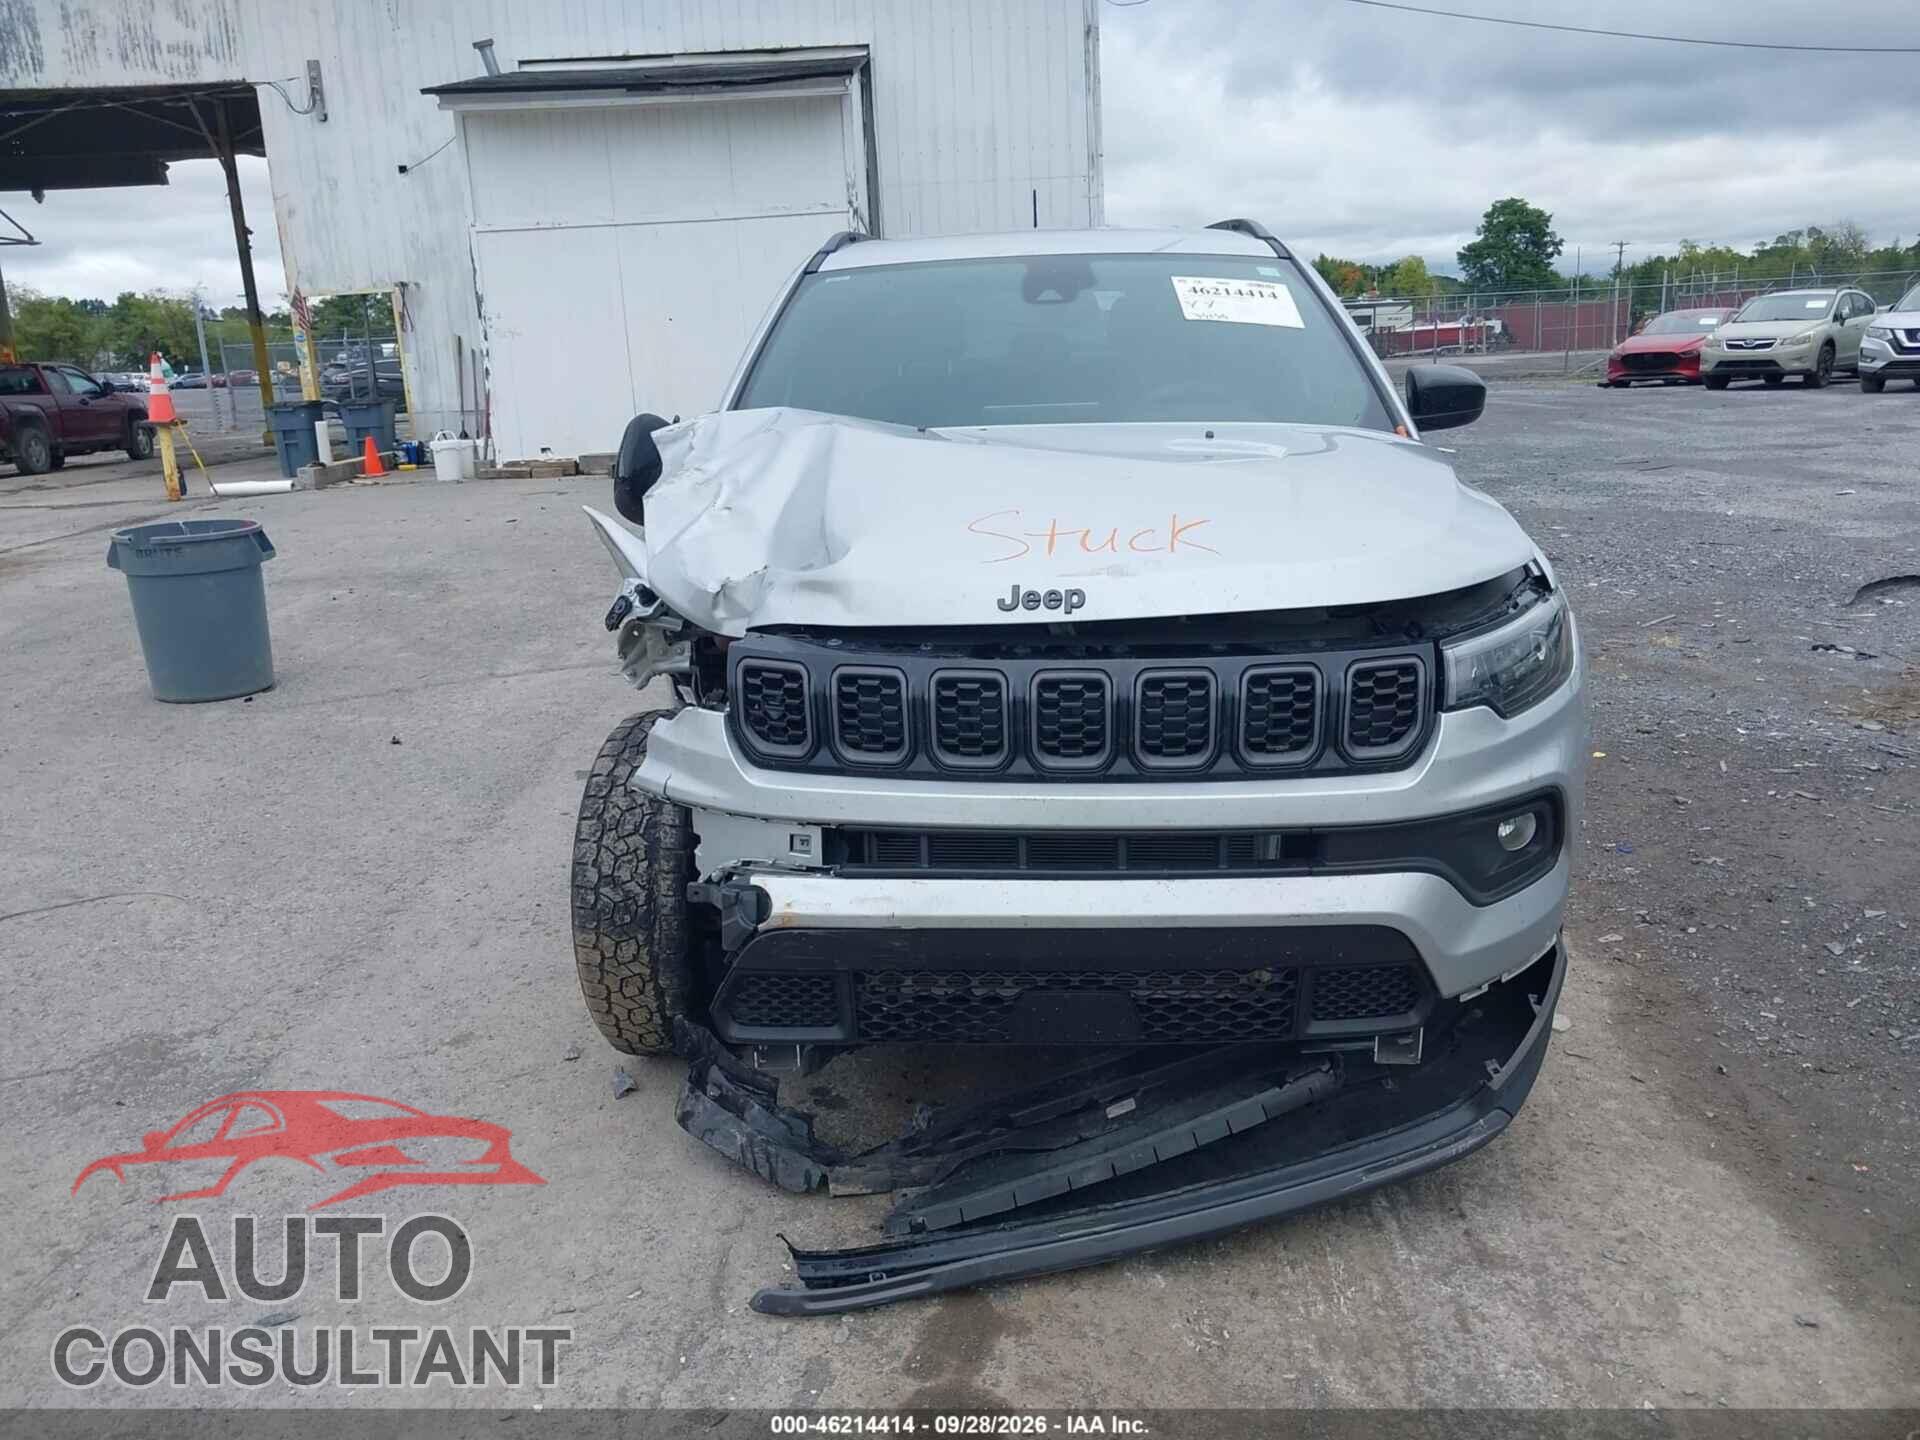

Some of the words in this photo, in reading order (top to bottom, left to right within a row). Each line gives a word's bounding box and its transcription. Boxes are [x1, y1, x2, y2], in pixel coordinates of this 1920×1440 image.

[1188, 285, 1279, 300] 46214414
[967, 509, 1223, 564] Stuck
[996, 584, 1087, 614] Jeep
